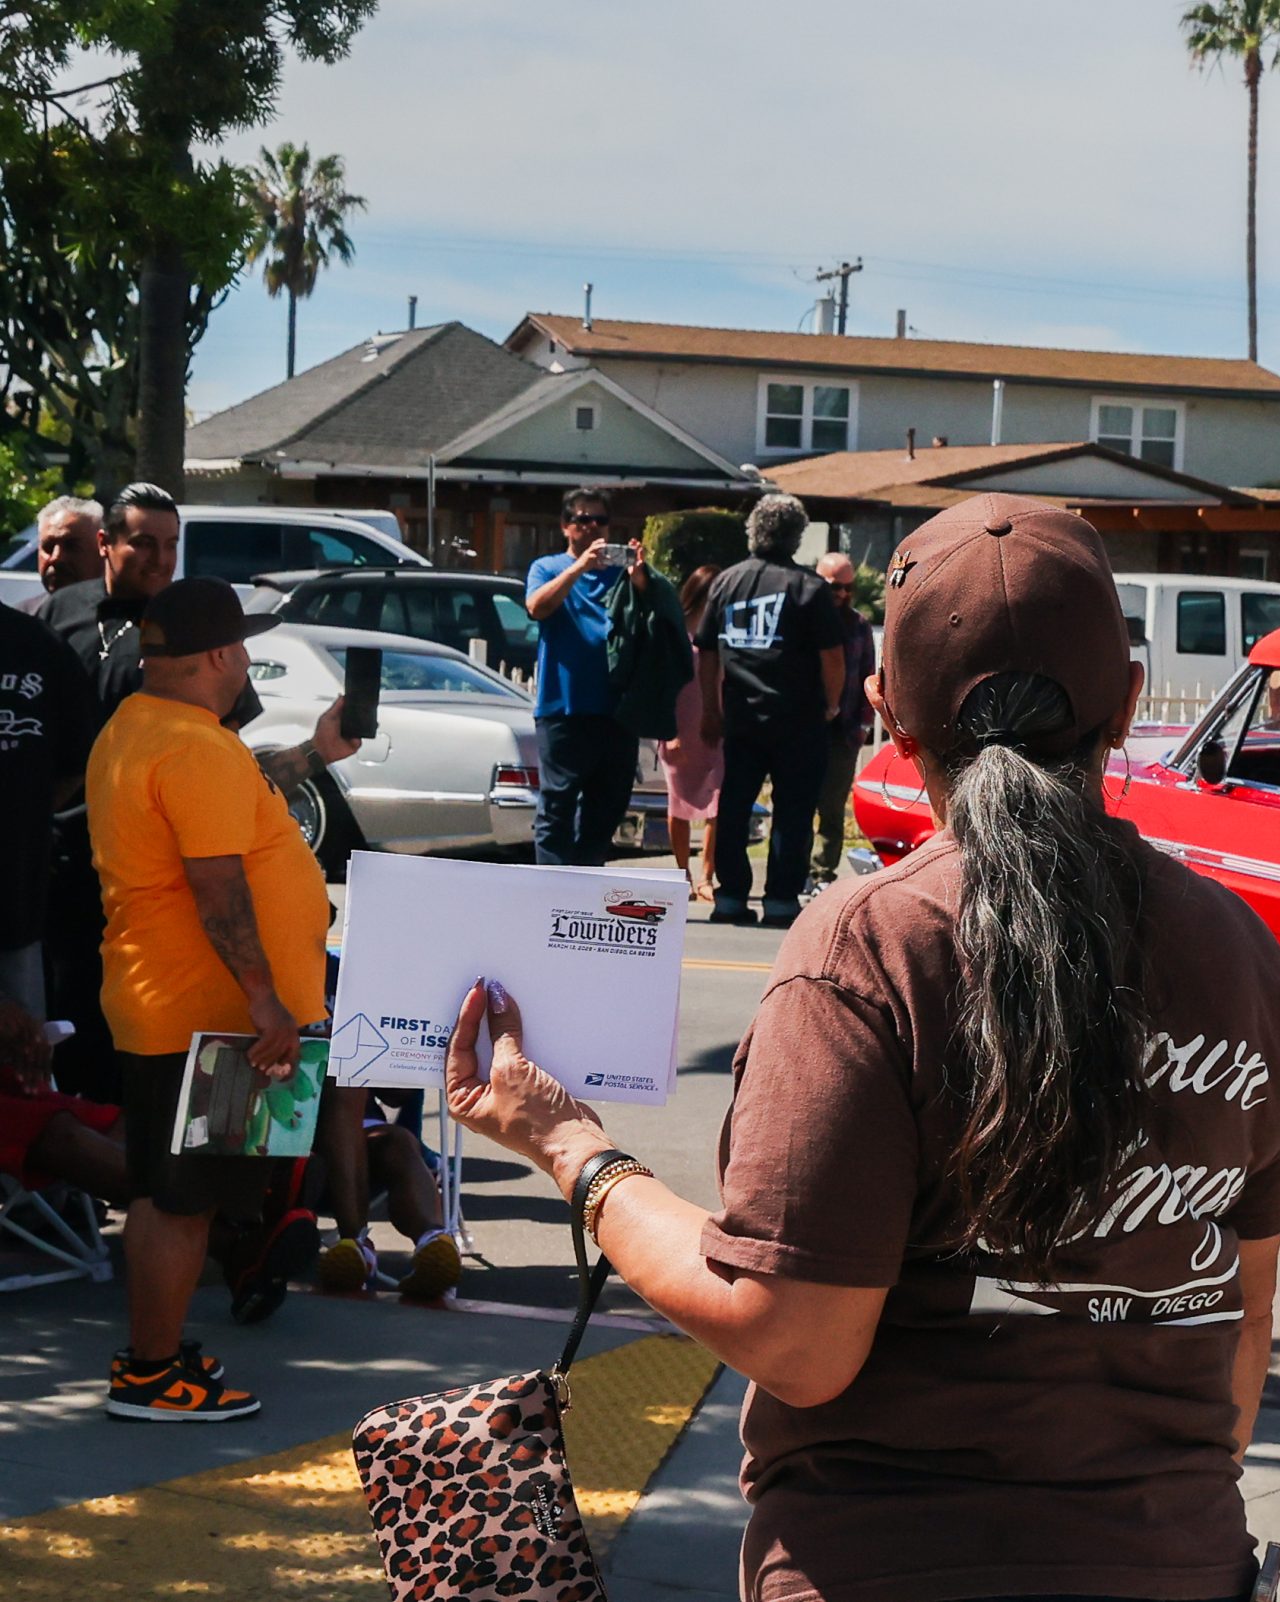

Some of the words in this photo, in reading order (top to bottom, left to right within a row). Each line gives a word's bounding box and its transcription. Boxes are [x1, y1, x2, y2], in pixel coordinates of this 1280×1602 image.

[550, 915, 658, 946] Lowriders
[380, 1016, 431, 1032] FIRST
[434, 1024, 455, 1034] DA
[400, 1036, 417, 1046] OF
[420, 1035, 449, 1049] ISS
[390, 1050, 432, 1060] CEREMONY
[604, 1081, 627, 1089] POSTAL
[606, 1074, 631, 1082] UNITED
[632, 1076, 654, 1084] STATES
[1087, 1297, 1133, 1323] SAN
[1150, 1290, 1224, 1317] DIEGO
